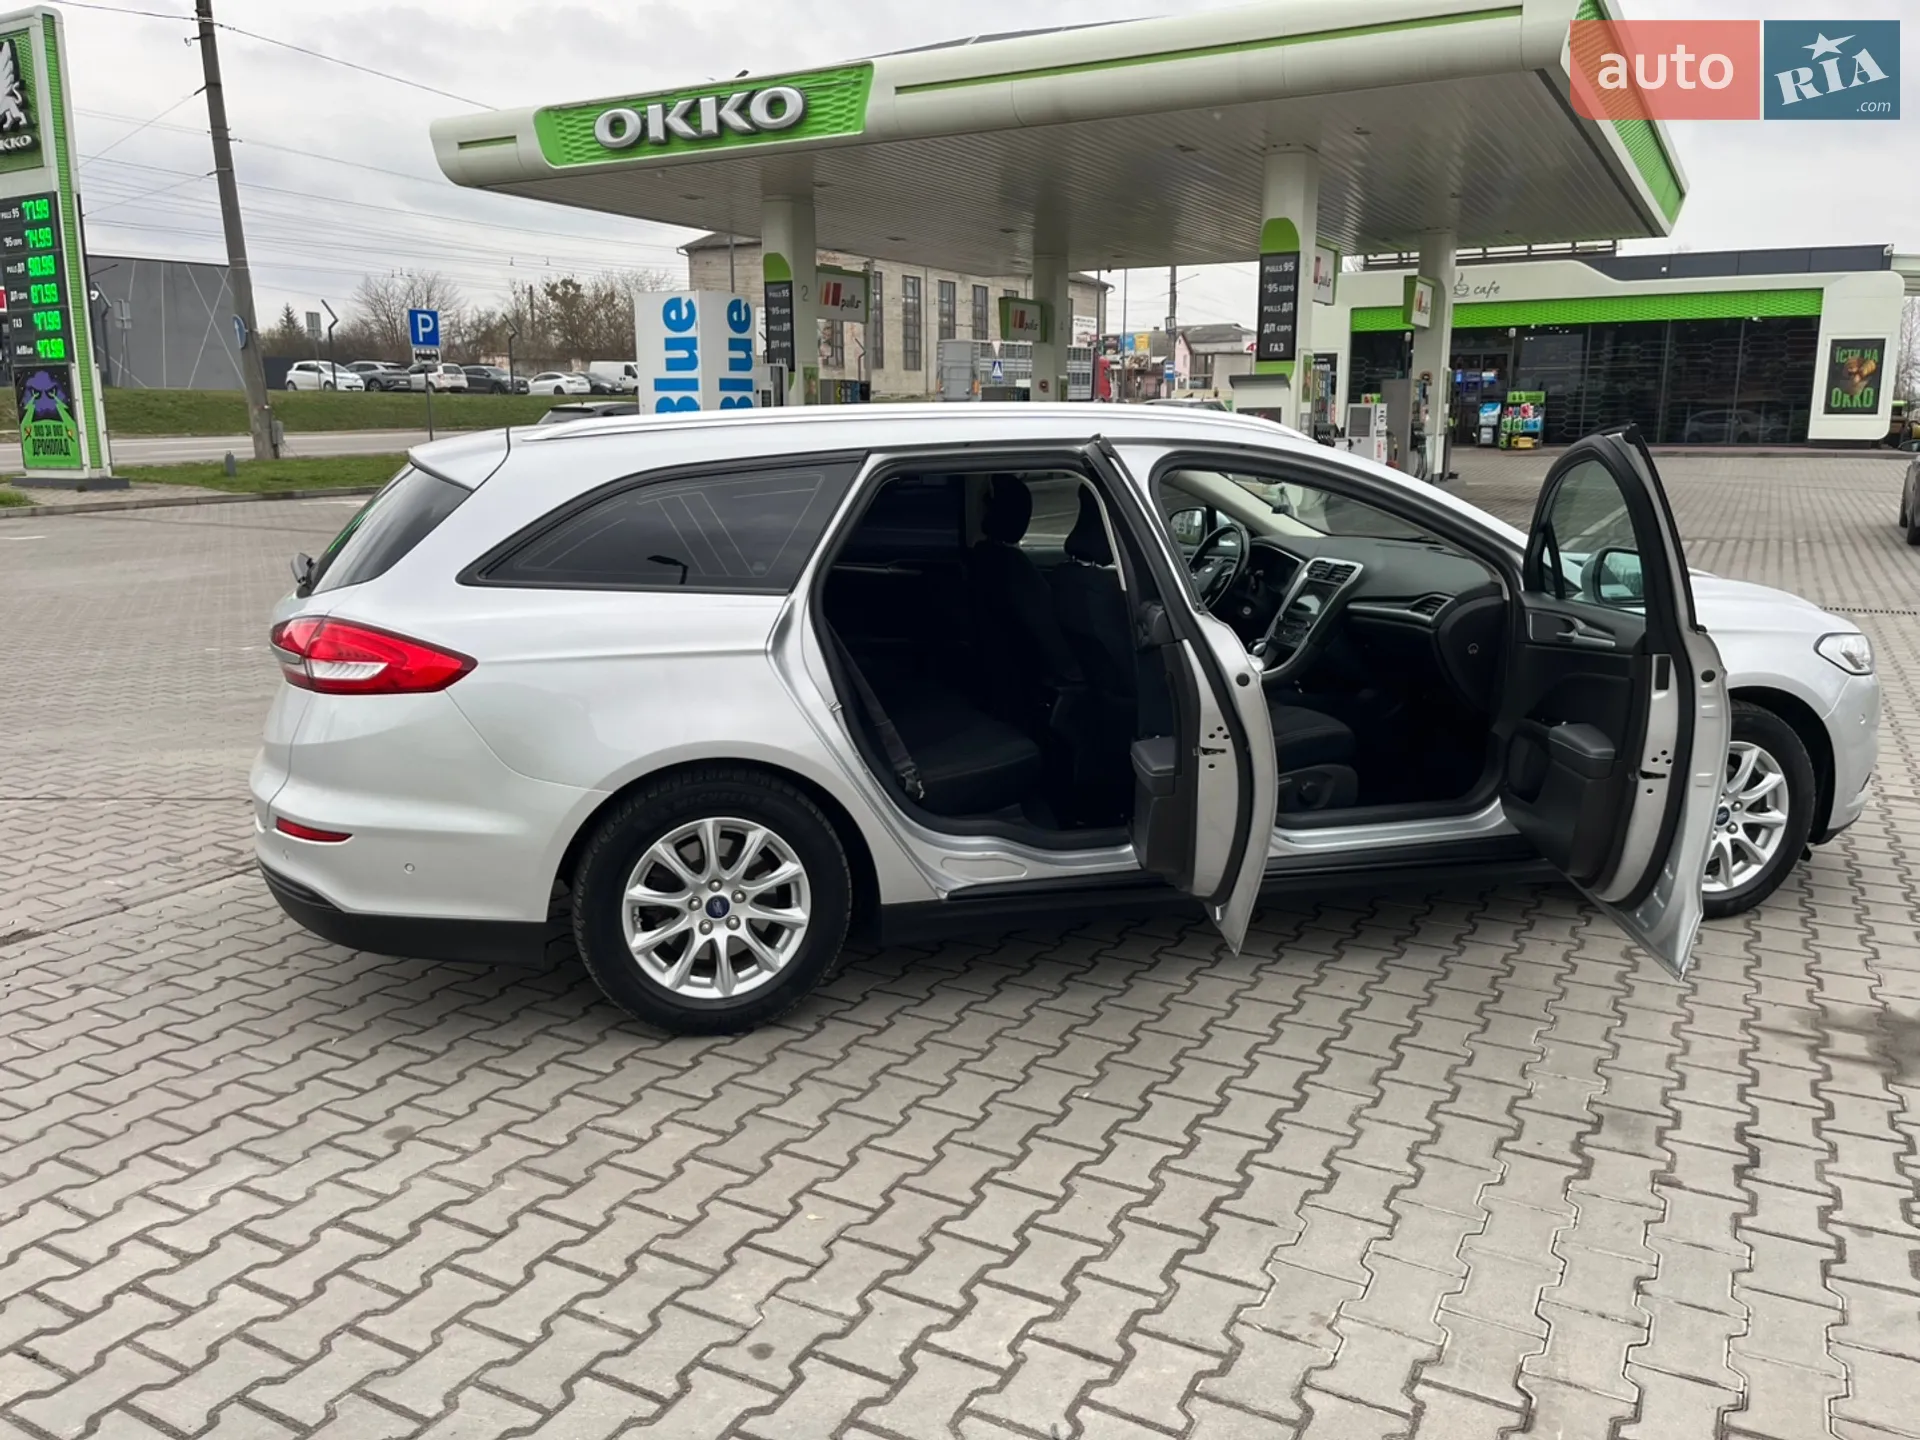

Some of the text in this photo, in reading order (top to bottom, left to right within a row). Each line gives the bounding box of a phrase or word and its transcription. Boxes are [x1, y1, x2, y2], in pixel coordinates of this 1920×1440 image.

[593, 86, 804, 149] OKKO
[0, 135, 32, 151] KKO
[1283, 262, 1294, 272] 95
[801, 285, 808, 302] 2
[1473, 281, 1500, 298] cafe
[417, 313, 434, 342] P
[1269, 343, 1284, 352] ГАЗ
